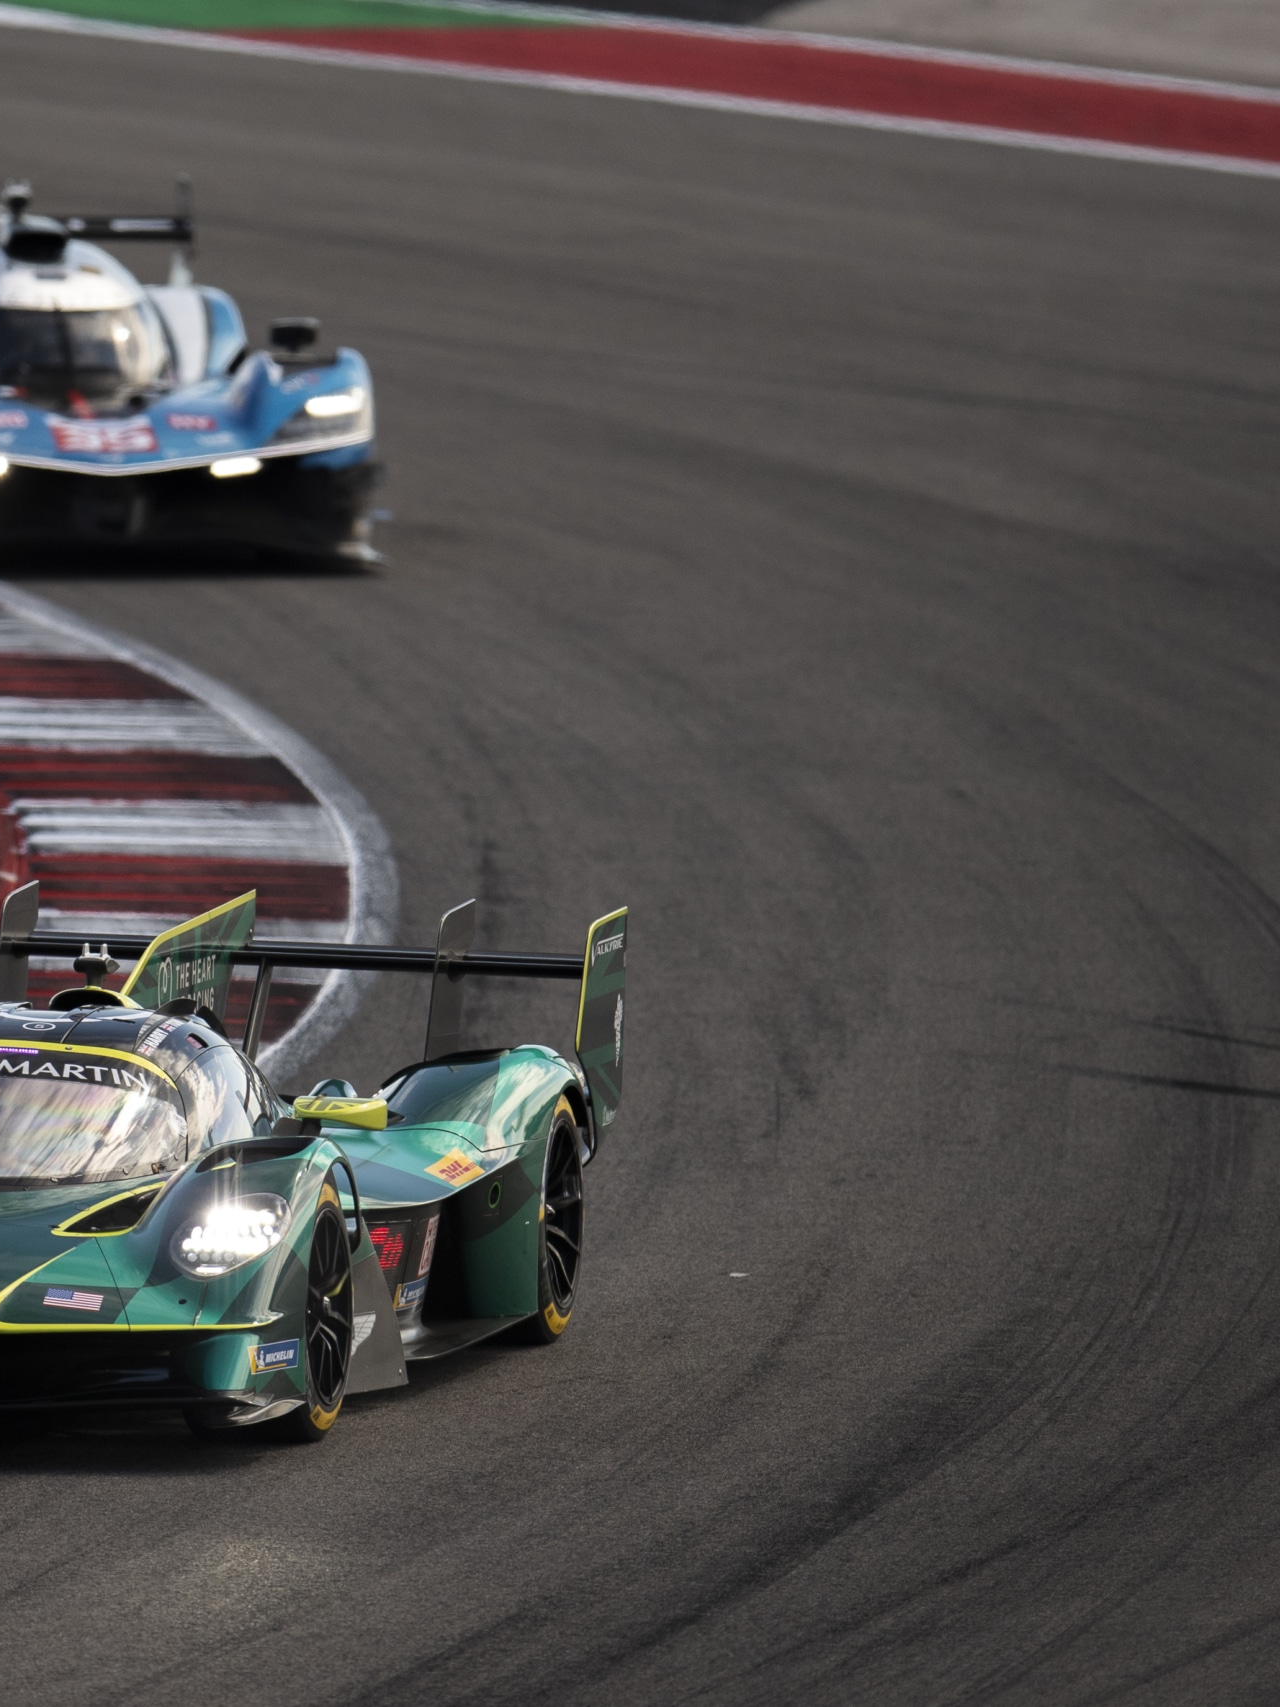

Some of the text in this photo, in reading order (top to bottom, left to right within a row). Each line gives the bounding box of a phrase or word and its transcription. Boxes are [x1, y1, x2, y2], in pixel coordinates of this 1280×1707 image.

[592, 933, 624, 967] VALKYRIE
[176, 954, 216, 990] THE HEART
[187, 987, 215, 1014] CING
[144, 1027, 169, 1049] HARRY
[265, 1350, 294, 1363] MICHELIN
